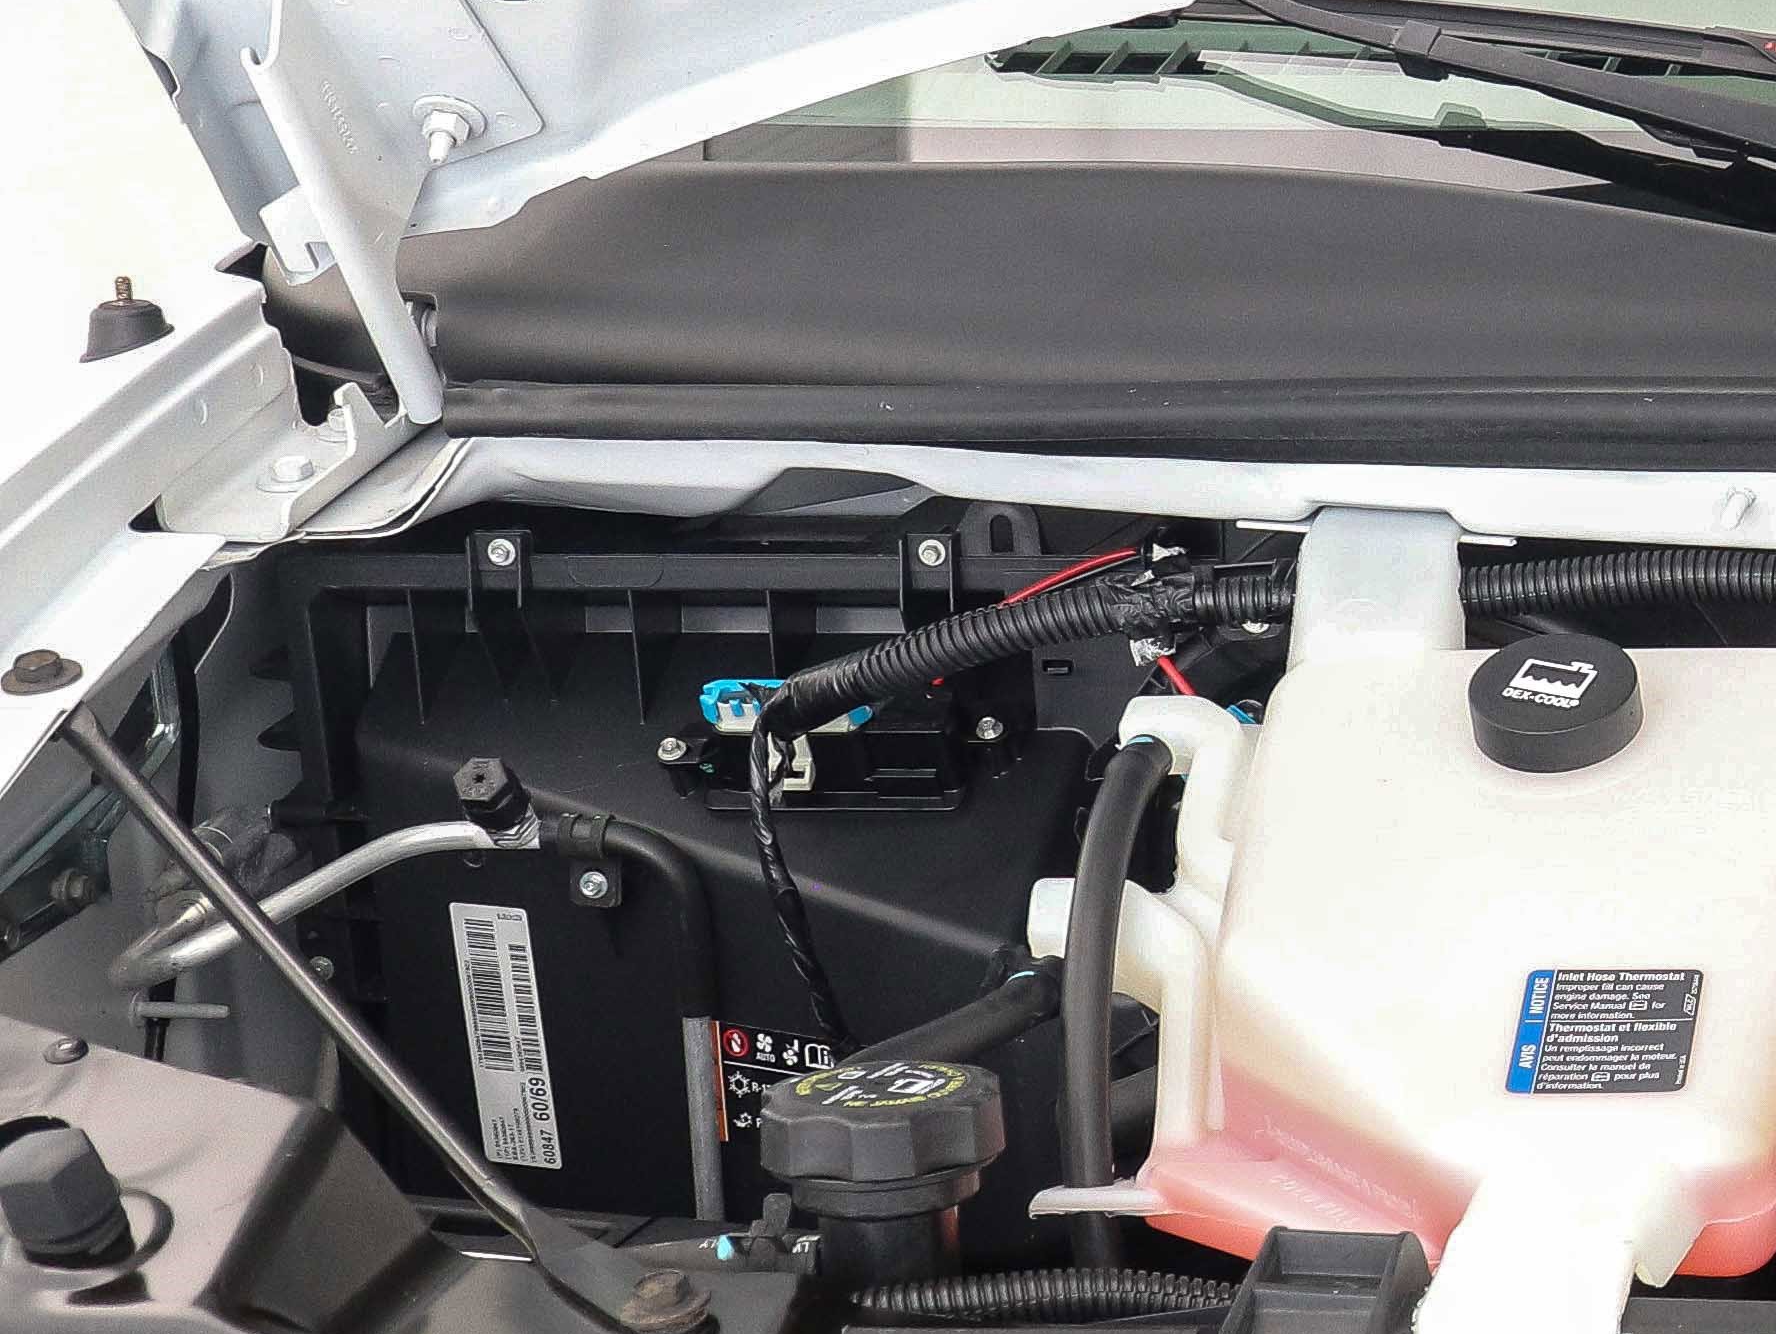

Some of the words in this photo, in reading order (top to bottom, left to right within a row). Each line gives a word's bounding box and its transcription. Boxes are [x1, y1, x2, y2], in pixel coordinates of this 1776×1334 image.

[1557, 972, 1584, 982] Inlet
[1586, 972, 1615, 982] Hose
[1619, 972, 1685, 982] Thermostat
[1555, 983, 1603, 992] Improper
[1601, 982, 1614, 991] fill
[1616, 983, 1634, 991] can
[1635, 983, 1665, 991] cause
[1529, 978, 1550, 1014] NOTICE
[1554, 992, 1586, 1001] engine
[1588, 992, 1630, 1001] damage.
[1632, 992, 1651, 1000] See
[1552, 1002, 1589, 1010] Service
[1590, 1002, 1626, 1010] Manual
[1651, 1001, 1666, 1009] for
[1577, 1011, 1635, 1020] information.
[1549, 1023, 1616, 1033] Thermostat
[1618, 1023, 1632, 1032] et
[1634, 1022, 1677, 1031] flexible
[1546, 1033, 1619, 1043] d'admission
[1544, 1043, 1560, 1052] Un
[1559, 1044, 1619, 1053] remplissage
[1620, 1043, 1664, 1052] incorrect
[1519, 1044, 1537, 1069] AVIS
[1541, 1054, 1564, 1063] peut
[1565, 1054, 1628, 1063] endommager
[1630, 1053, 1639, 1061] la
[1641, 1053, 1678, 1061] moteur.
[1540, 1062, 1586, 1071] Consulter
[1599, 1062, 1636, 1071] manuel
[1638, 1062, 1651, 1070] de
[1537, 1071, 1589, 1082] réparation
[1613, 1072, 1637, 1082] pour
[1638, 1071, 1660, 1081] plus
[1536, 1081, 1604, 1090] d'information.
[527, 1076, 551, 1122] 60/69
[540, 1129, 557, 1165] 60847
